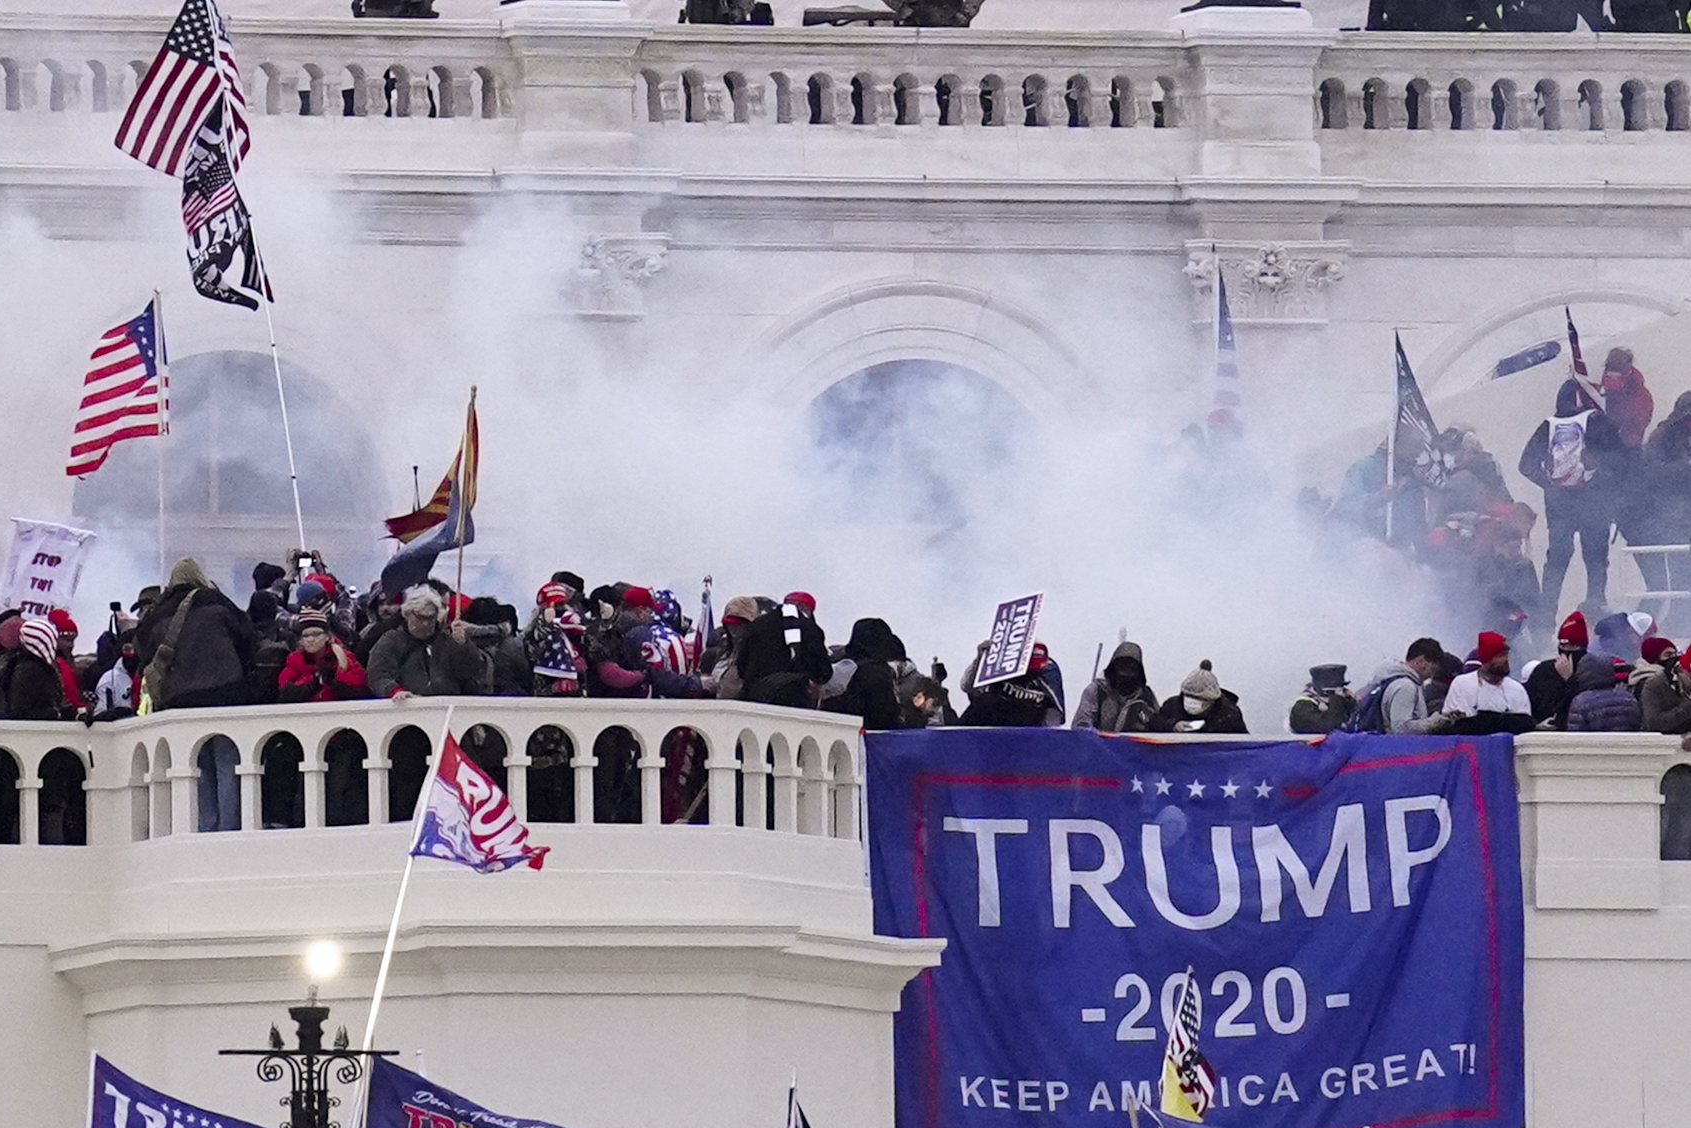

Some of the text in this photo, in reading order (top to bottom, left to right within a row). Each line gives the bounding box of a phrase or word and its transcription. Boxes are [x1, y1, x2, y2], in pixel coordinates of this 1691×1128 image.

[1001, 600, 1034, 672] TRUMP
[943, 794, 1452, 931] TRUMP
[960, 1075, 1070, 1112] KEEP
[1089, 1073, 1300, 1112] AMICA
